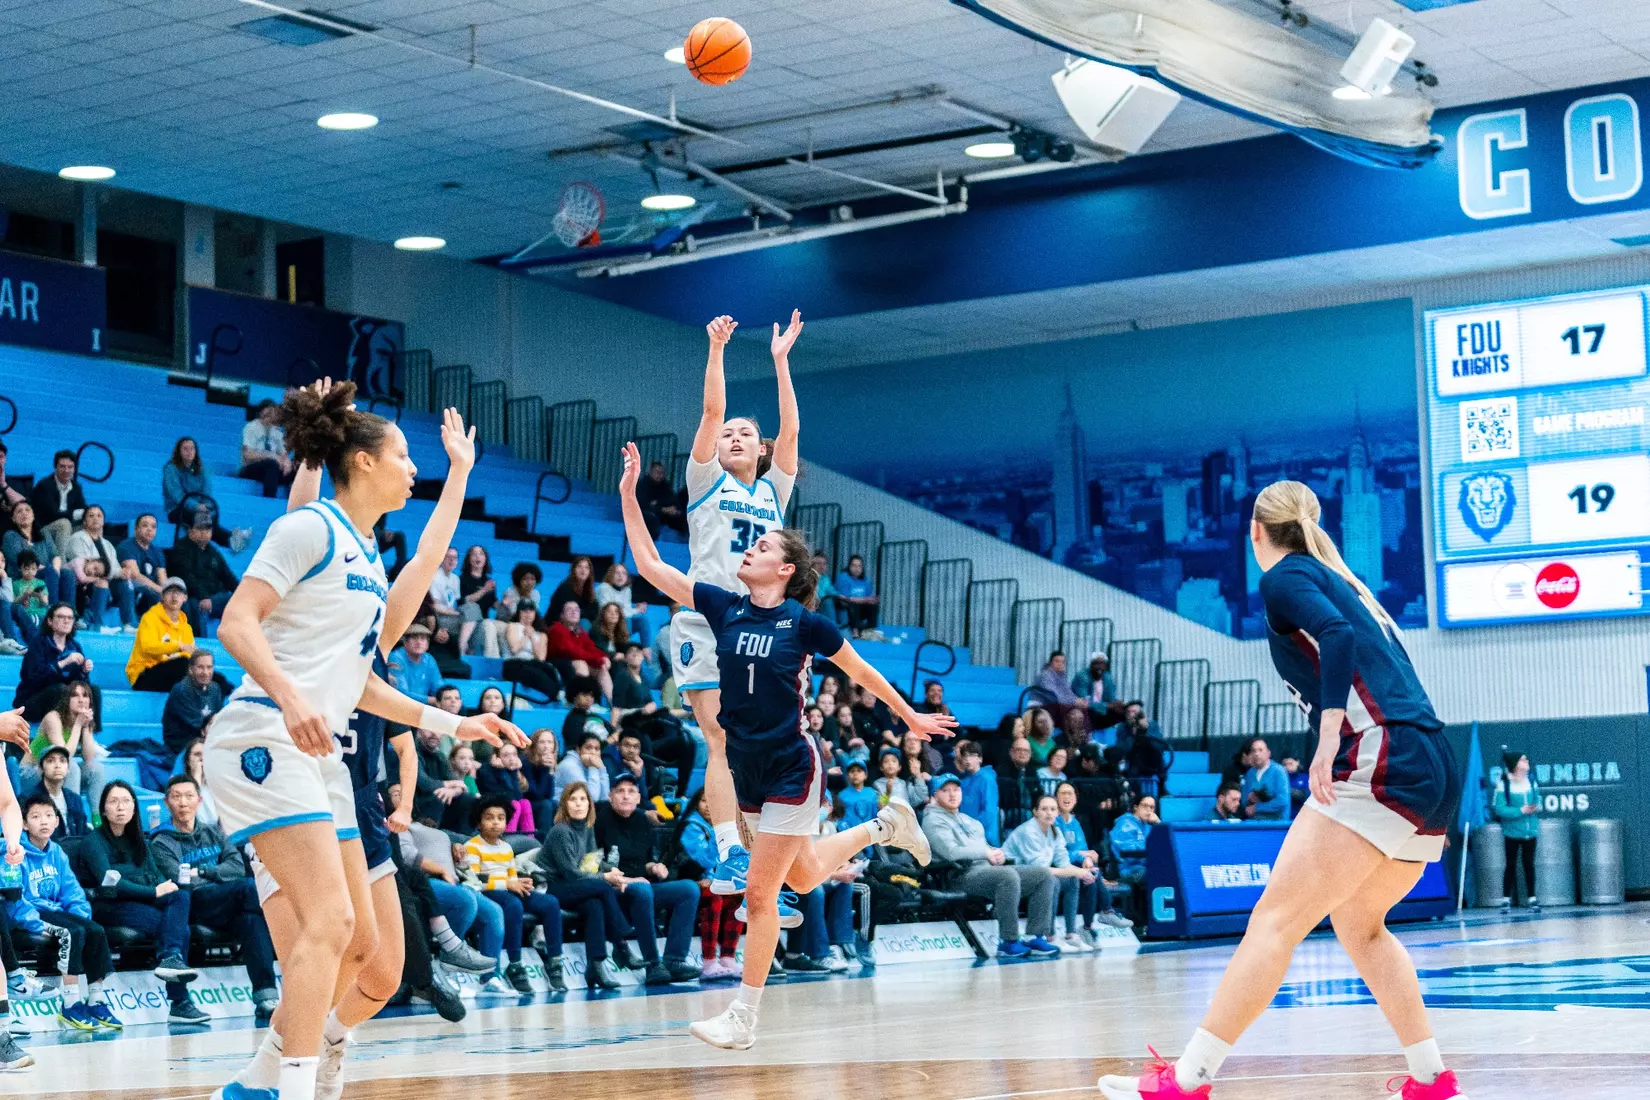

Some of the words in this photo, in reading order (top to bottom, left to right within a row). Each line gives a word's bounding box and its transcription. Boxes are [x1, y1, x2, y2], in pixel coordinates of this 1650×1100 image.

[0, 277, 39, 323] AR
[1457, 320, 1502, 356] FDU
[1560, 322, 1606, 355] 17
[195, 343, 207, 365] J
[1452, 354, 1509, 378] KNIGHTS
[719, 499, 776, 522] COLUMBIA
[1568, 482, 1616, 514] 19
[736, 631, 774, 658] FDU
[747, 663, 755, 694] 1
[1490, 761, 1621, 785] CUMBIA
[1152, 886, 1176, 922] C
[878, 932, 966, 952] TicketSmarter
